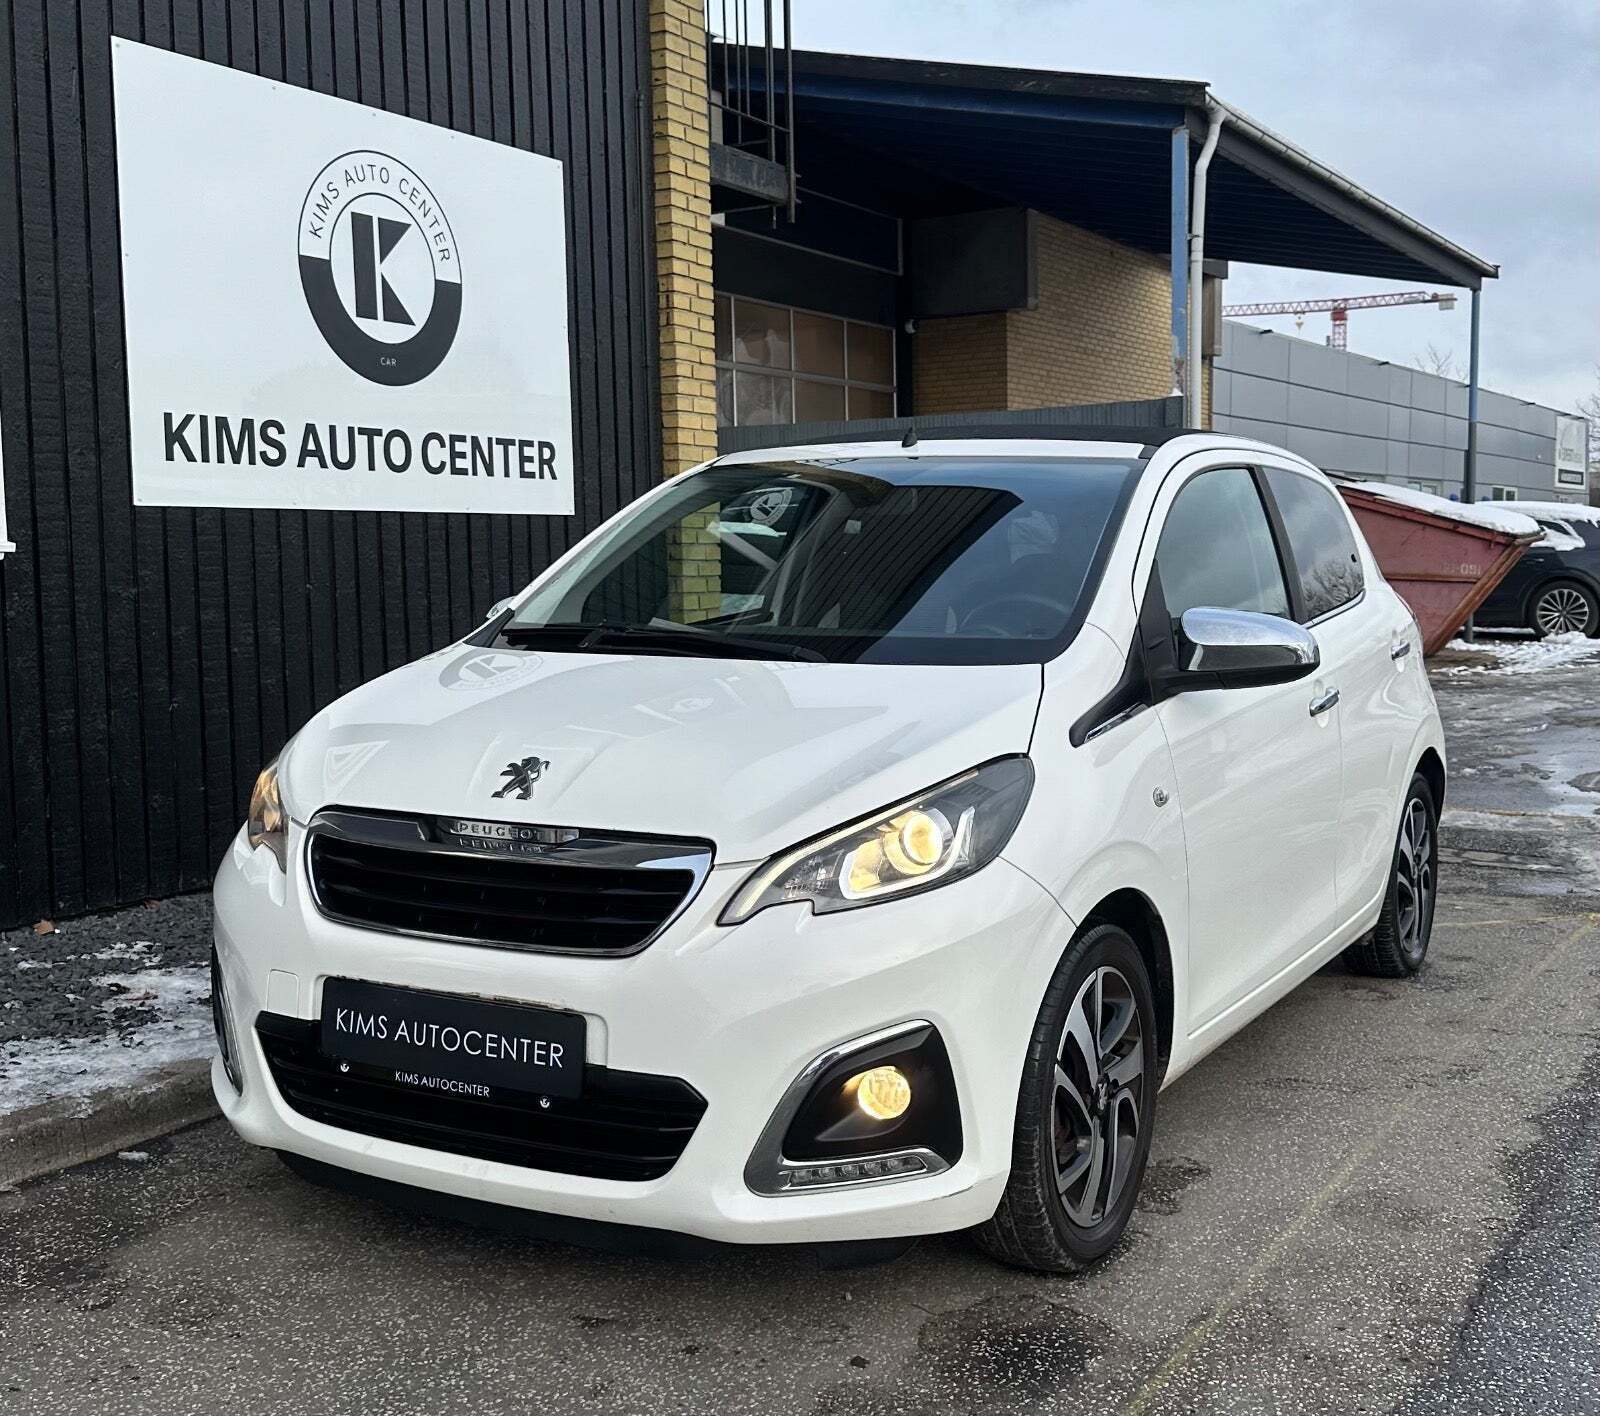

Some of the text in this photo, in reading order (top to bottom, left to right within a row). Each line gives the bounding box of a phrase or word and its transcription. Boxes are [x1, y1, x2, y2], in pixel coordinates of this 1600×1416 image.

[309, 163, 451, 263] KIMS AUTO CENTER
[380, 357, 397, 367] CAR
[163, 412, 558, 481] KIMS AUTO CENTER
[459, 822, 546, 841] PEUGEOT
[336, 1008, 564, 1067] KIMS AUTOCENTER
[395, 1071, 490, 1098] KIMS AUTOCENTER
